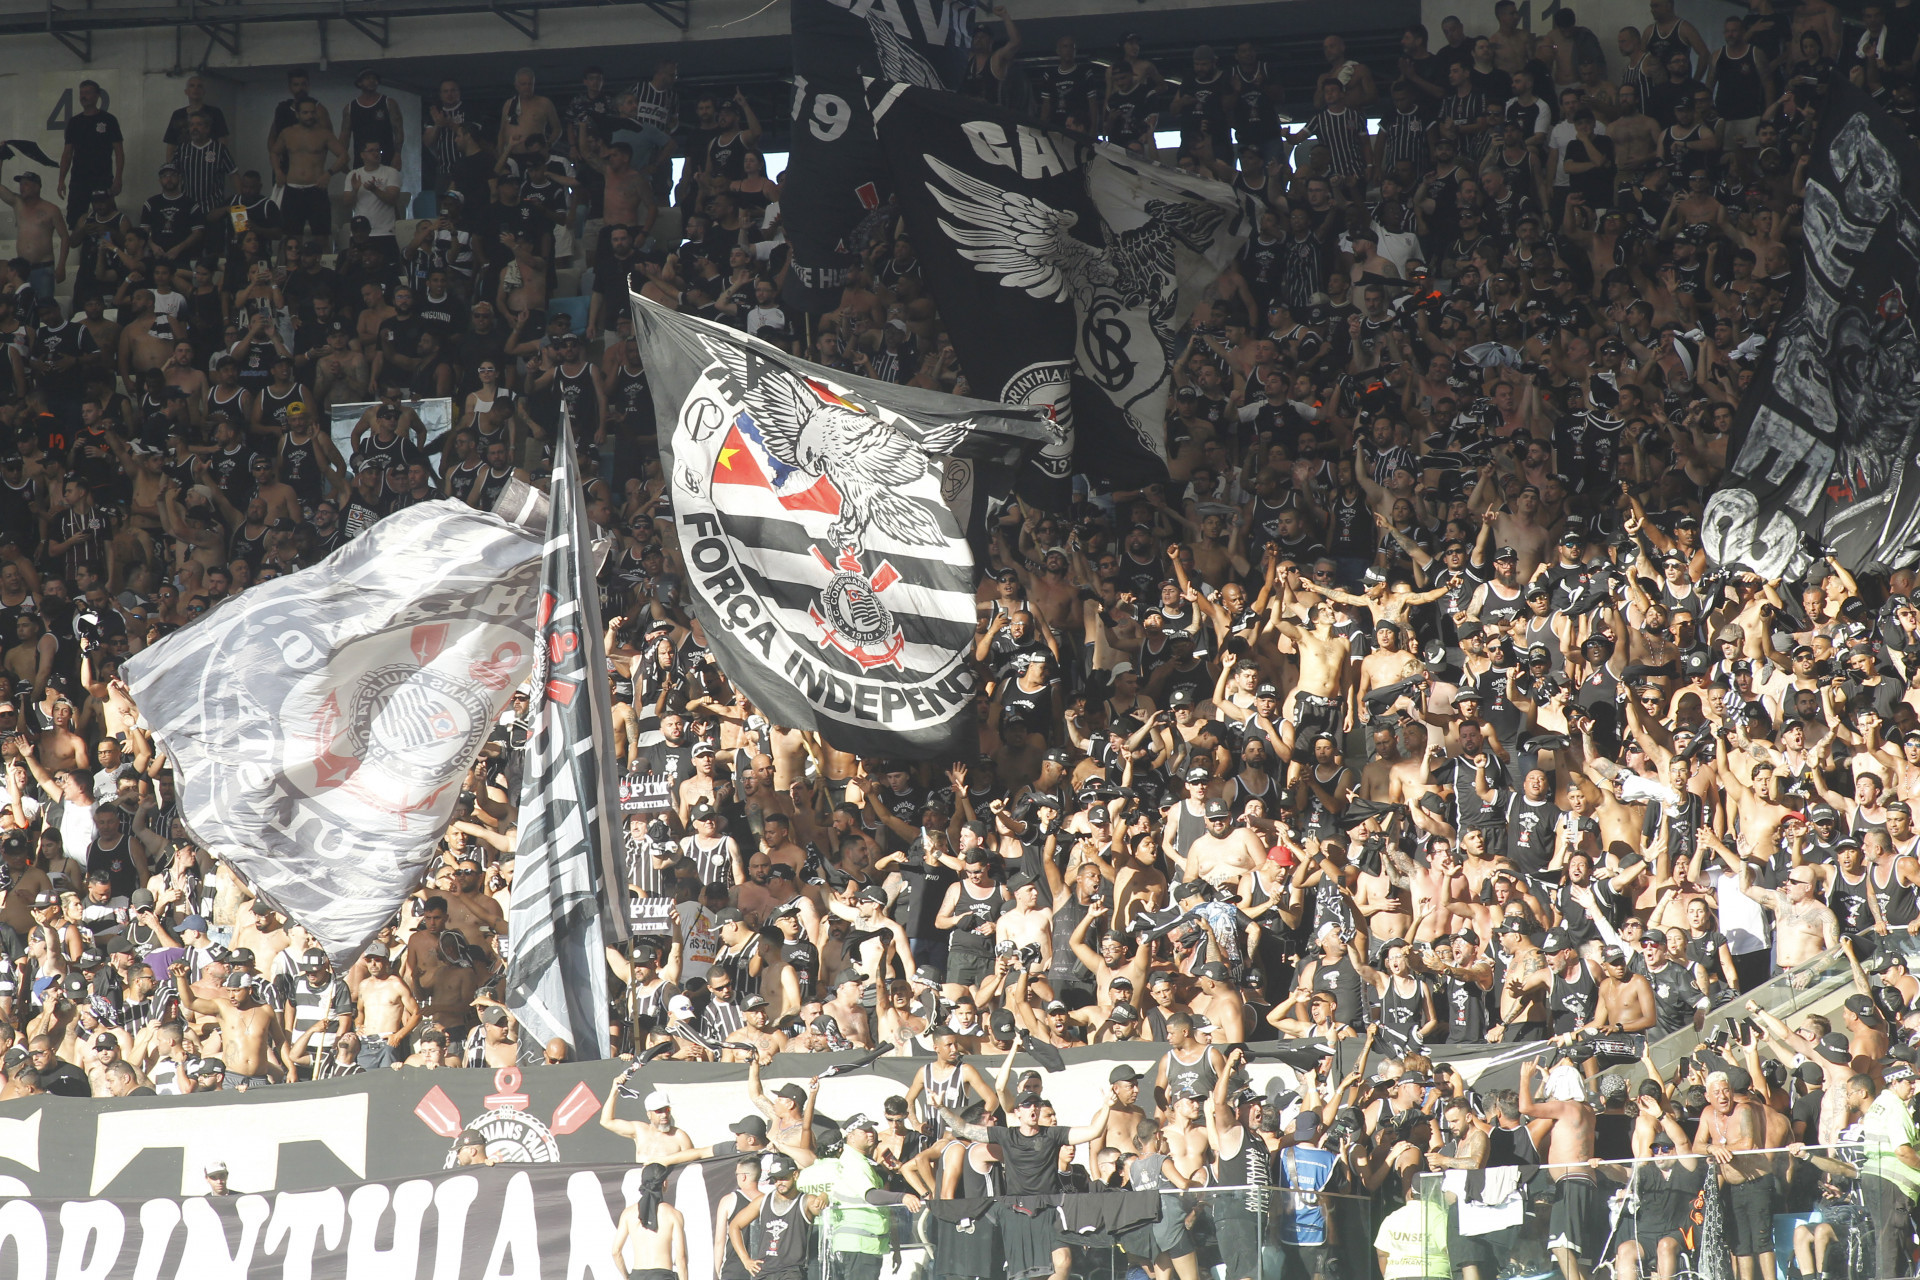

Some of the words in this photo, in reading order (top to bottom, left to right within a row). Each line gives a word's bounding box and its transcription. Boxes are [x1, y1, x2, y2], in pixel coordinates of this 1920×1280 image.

[683, 512, 778, 659] FORÇA
[851, 630, 874, 640] 1910
[630, 781, 670, 797] PIM
[624, 799, 670, 811] CURITIBA
[630, 904, 669, 918] PIM
[1177, 1072, 1200, 1080] GAVIÕES
